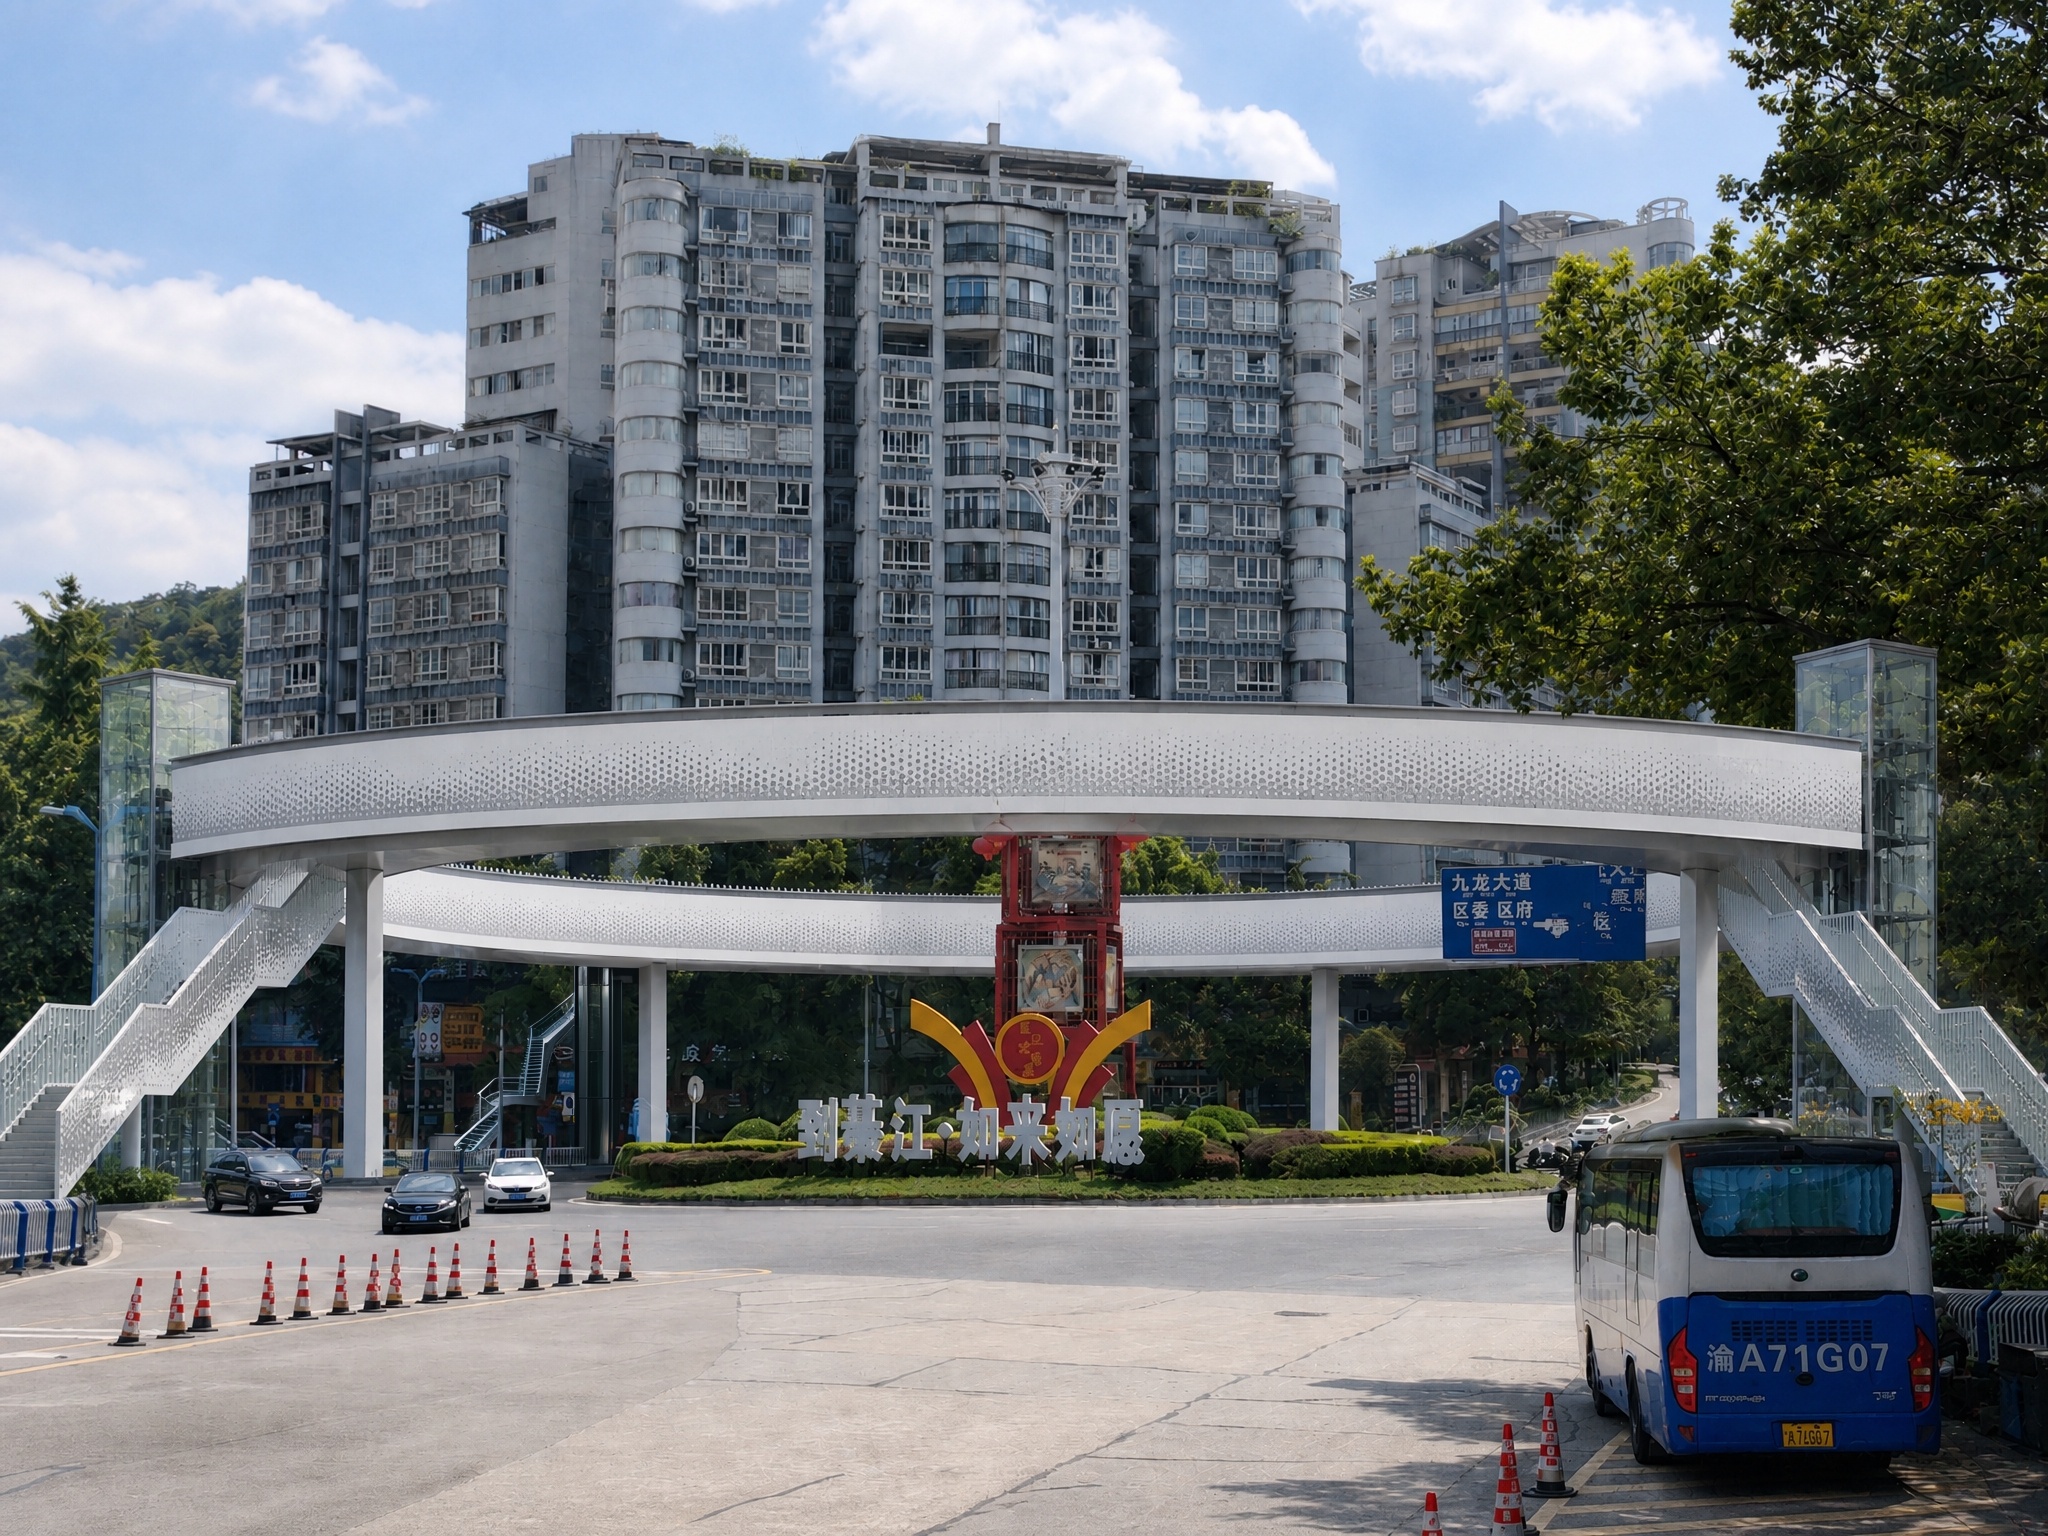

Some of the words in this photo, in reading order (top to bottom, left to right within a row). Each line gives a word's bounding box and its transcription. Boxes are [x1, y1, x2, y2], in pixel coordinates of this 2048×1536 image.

[1451, 872, 1532, 892] 九龙大道
[1453, 901, 1489, 920] 区委
[1497, 900, 1534, 919] 区府
[1707, 1343, 1889, 1373] 渝A71G07
